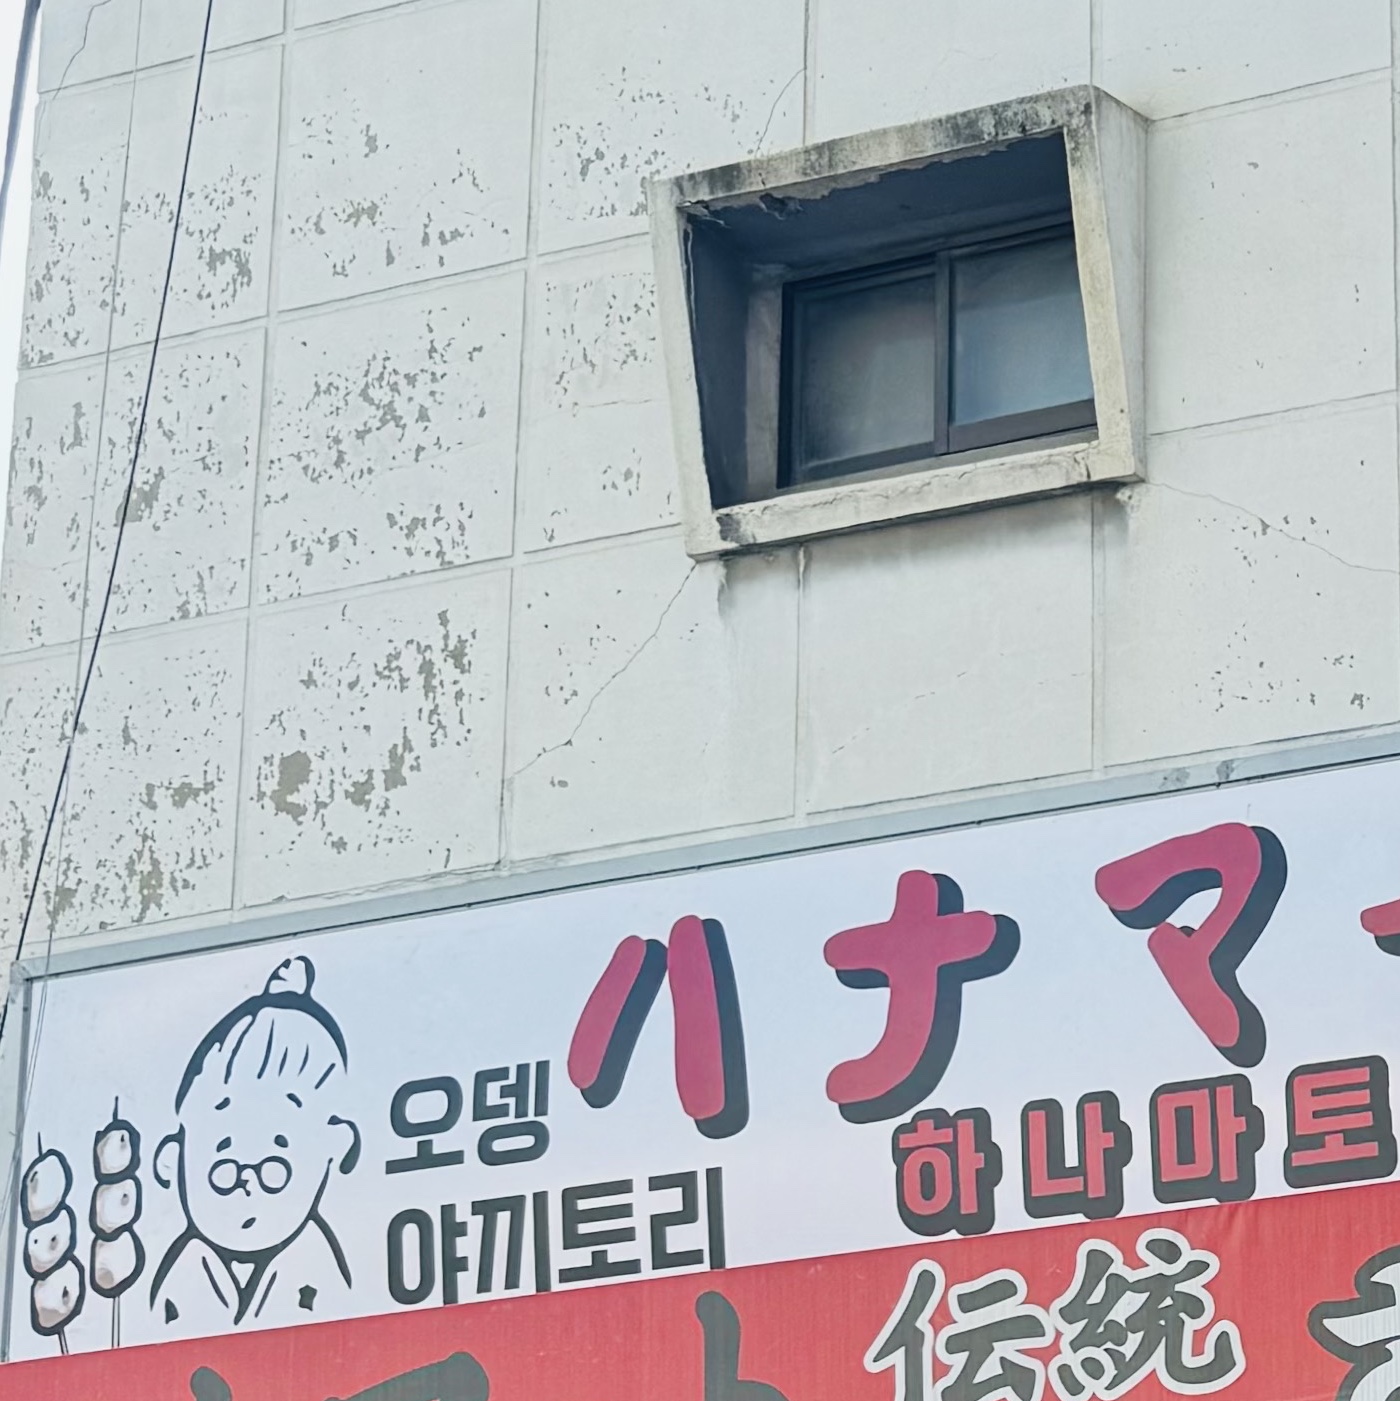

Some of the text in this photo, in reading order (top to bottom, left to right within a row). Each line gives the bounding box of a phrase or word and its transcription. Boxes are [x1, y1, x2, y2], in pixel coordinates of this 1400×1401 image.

[385, 1060, 550, 1174] 오뎅
[891, 1055, 1397, 1236] 하나마토
[387, 1167, 724, 1305] 야끼토리
